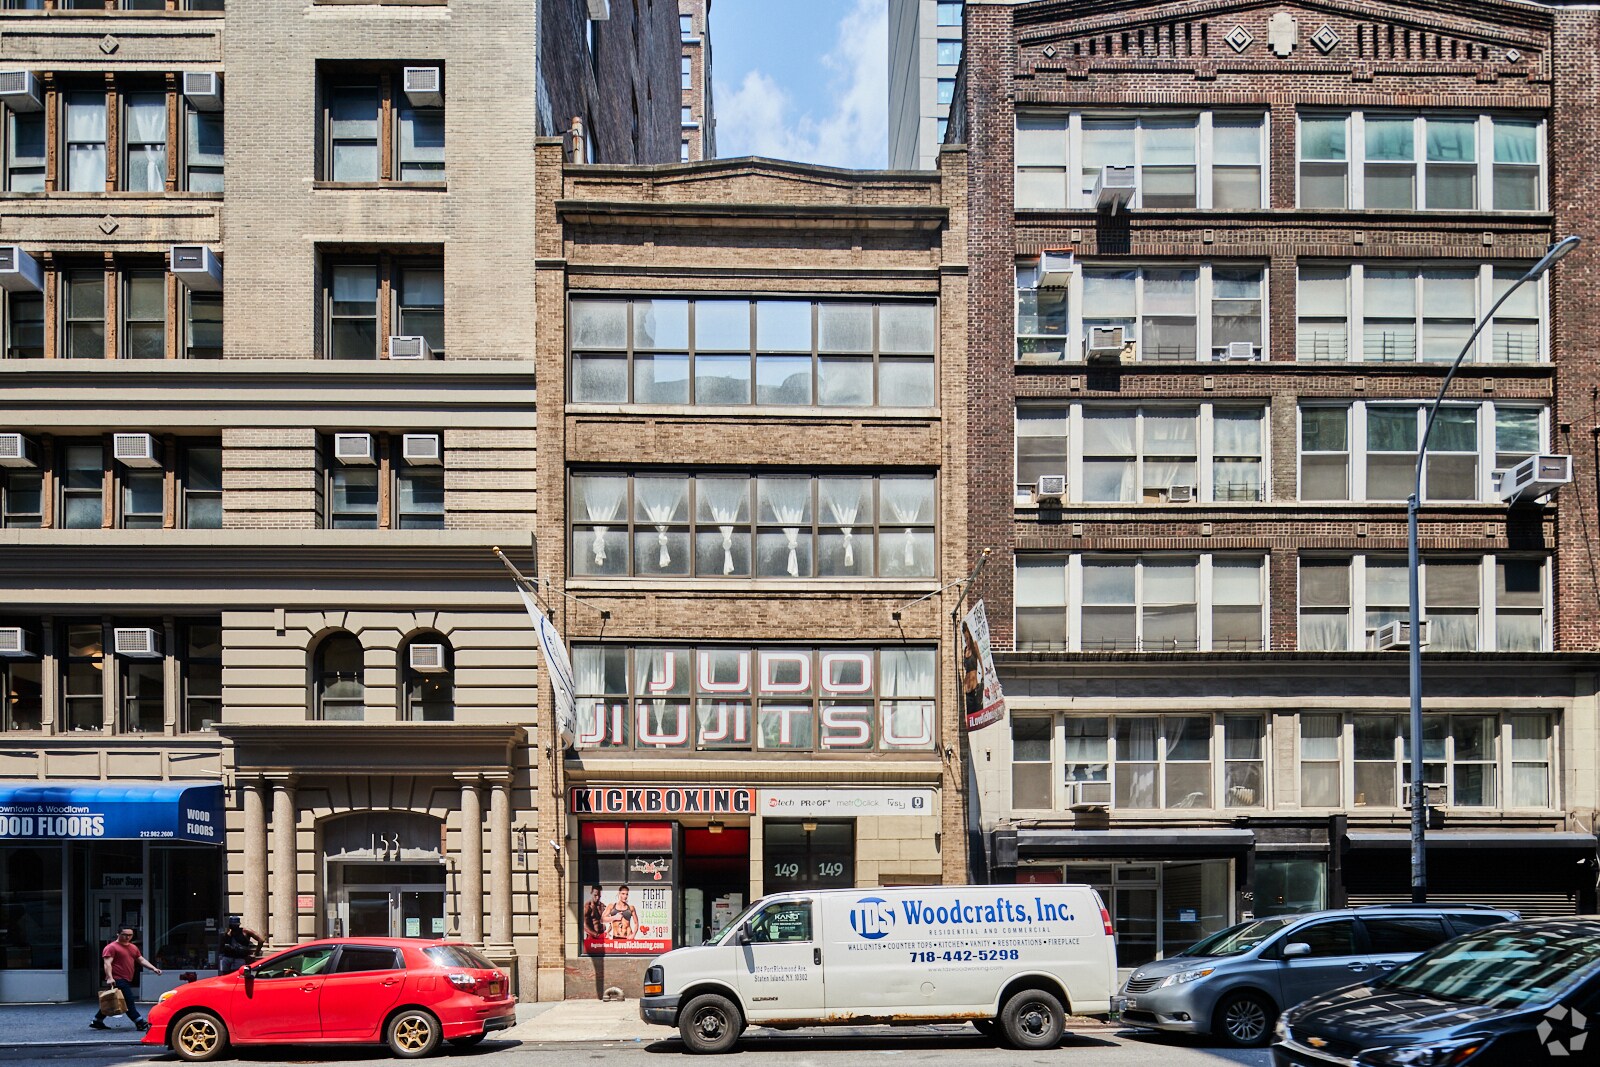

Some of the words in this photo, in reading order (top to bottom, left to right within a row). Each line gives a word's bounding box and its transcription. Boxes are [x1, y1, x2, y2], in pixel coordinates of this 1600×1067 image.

[649, 651, 872, 693] JUDO
[574, 788, 751, 813] KICKBOXING
[0, 805, 35, 813] owntown
[37, 805, 44, 813] &
[45, 805, 89, 813] Woodlawn
[186, 808, 210, 822] WOOD
[0, 816, 34, 836] OOD
[38, 816, 105, 837] FLOORS
[186, 822, 214, 837] FLOORS
[371, 832, 400, 857] 153
[774, 863, 799, 878] 149
[818, 862, 843, 876] 149
[104, 875, 124, 886] Floor
[126, 875, 143, 888] Supp
[642, 888, 666, 900] FIGHT
[642, 900, 652, 910] THE
[654, 900, 667, 910] FAT!
[902, 897, 1032, 925] Woodcrafts,
[1034, 897, 1075, 922] Inc.
[850, 900, 896, 935] TDS
[910, 950, 1019, 963] 718-442-5298
